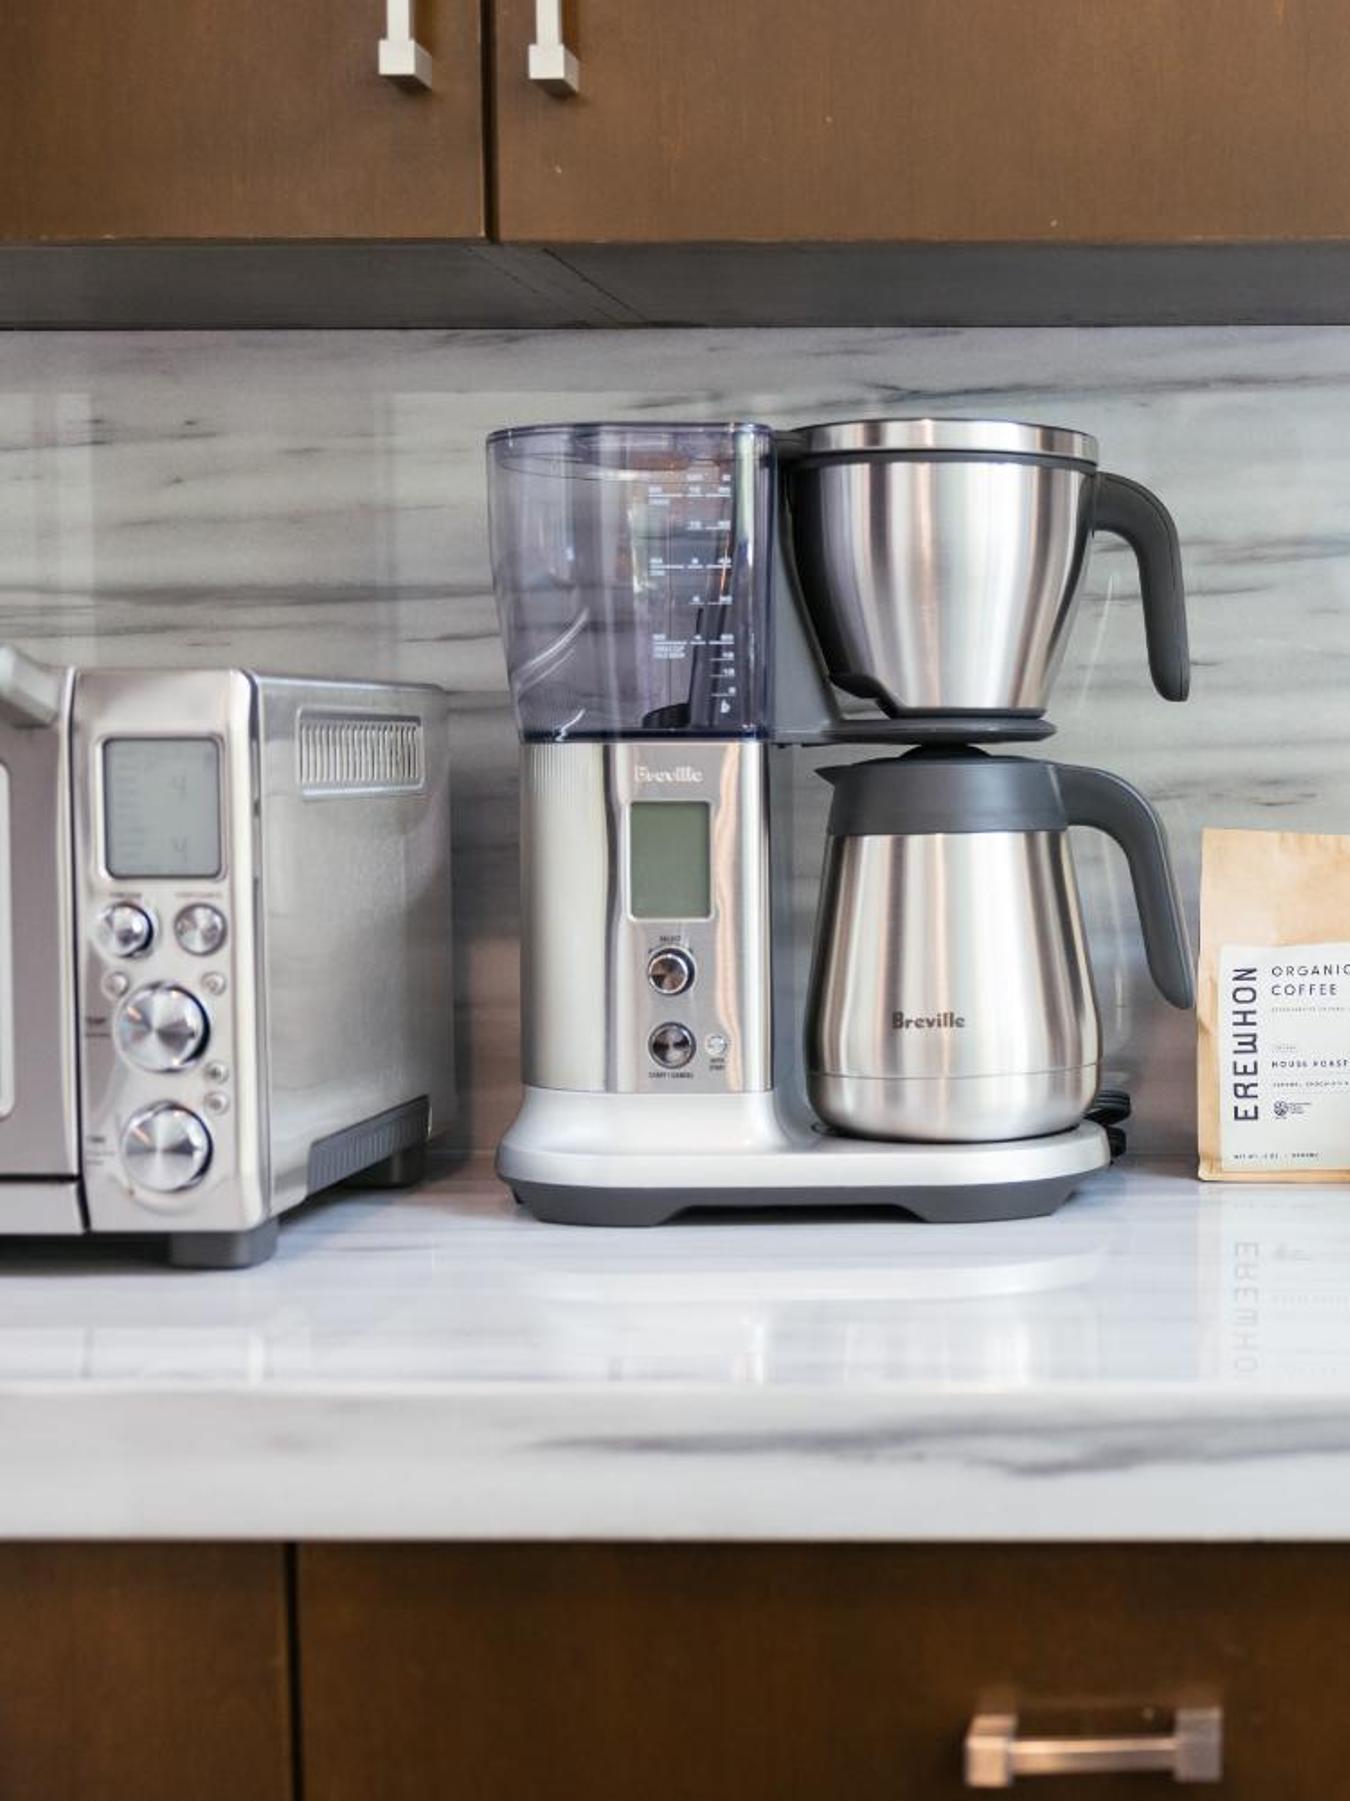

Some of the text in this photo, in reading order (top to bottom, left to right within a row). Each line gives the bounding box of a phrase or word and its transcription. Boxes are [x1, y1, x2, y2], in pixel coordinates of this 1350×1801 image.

[634, 766, 703, 783] Breville
[1271, 982, 1339, 997] COFFEE
[892, 1011, 966, 1029] Breville
[1231, 967, 1260, 1122] EREWHON
[1271, 1059, 1309, 1069] HOUSE
